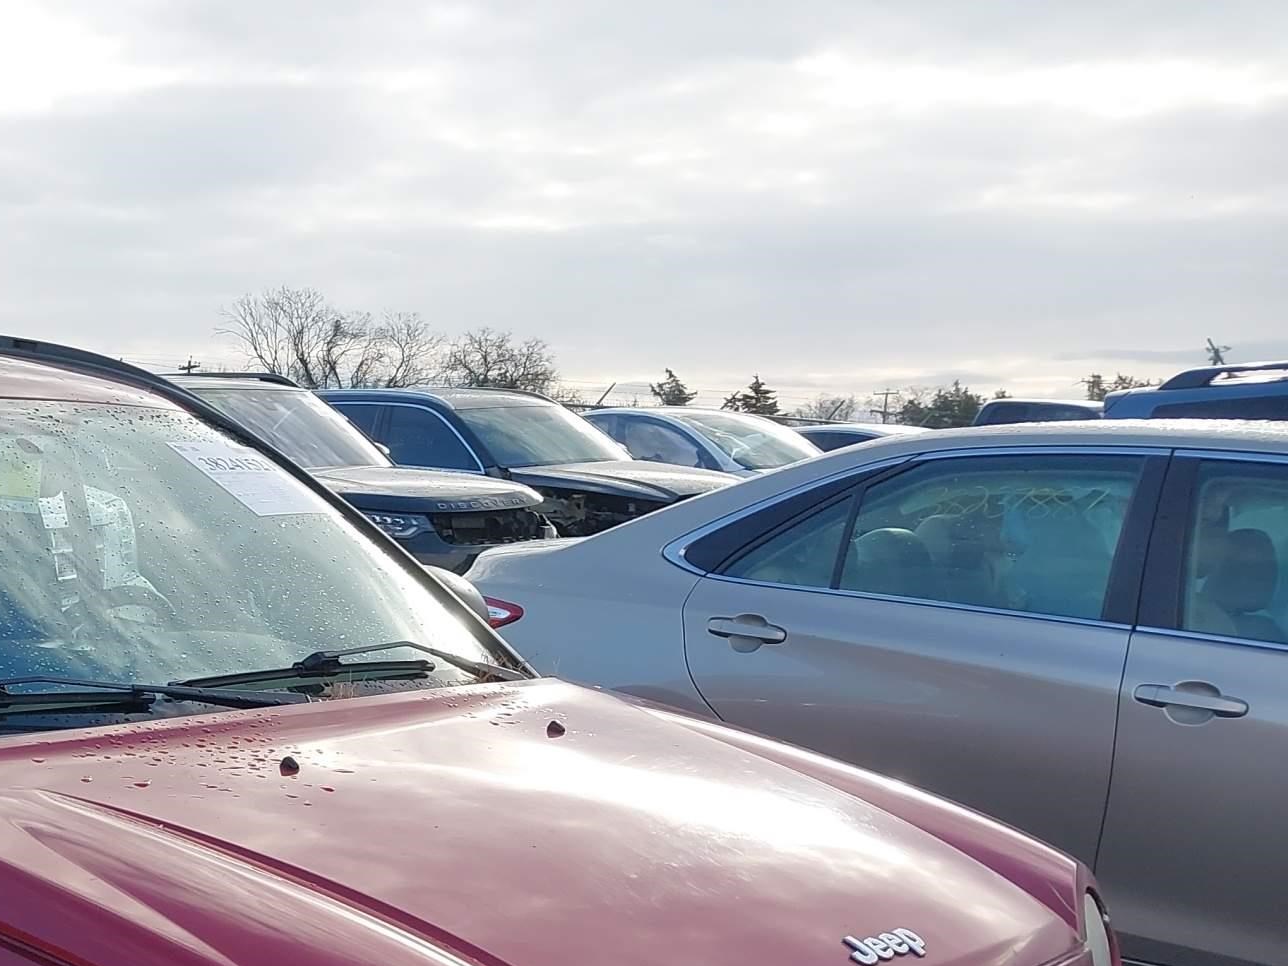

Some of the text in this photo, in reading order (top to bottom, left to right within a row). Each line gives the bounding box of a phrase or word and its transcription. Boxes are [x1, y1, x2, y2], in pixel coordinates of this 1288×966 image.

[198, 456, 277, 472] 38241521
[437, 496, 527, 510] DISCOVERY
[841, 927, 926, 966] Jeep
